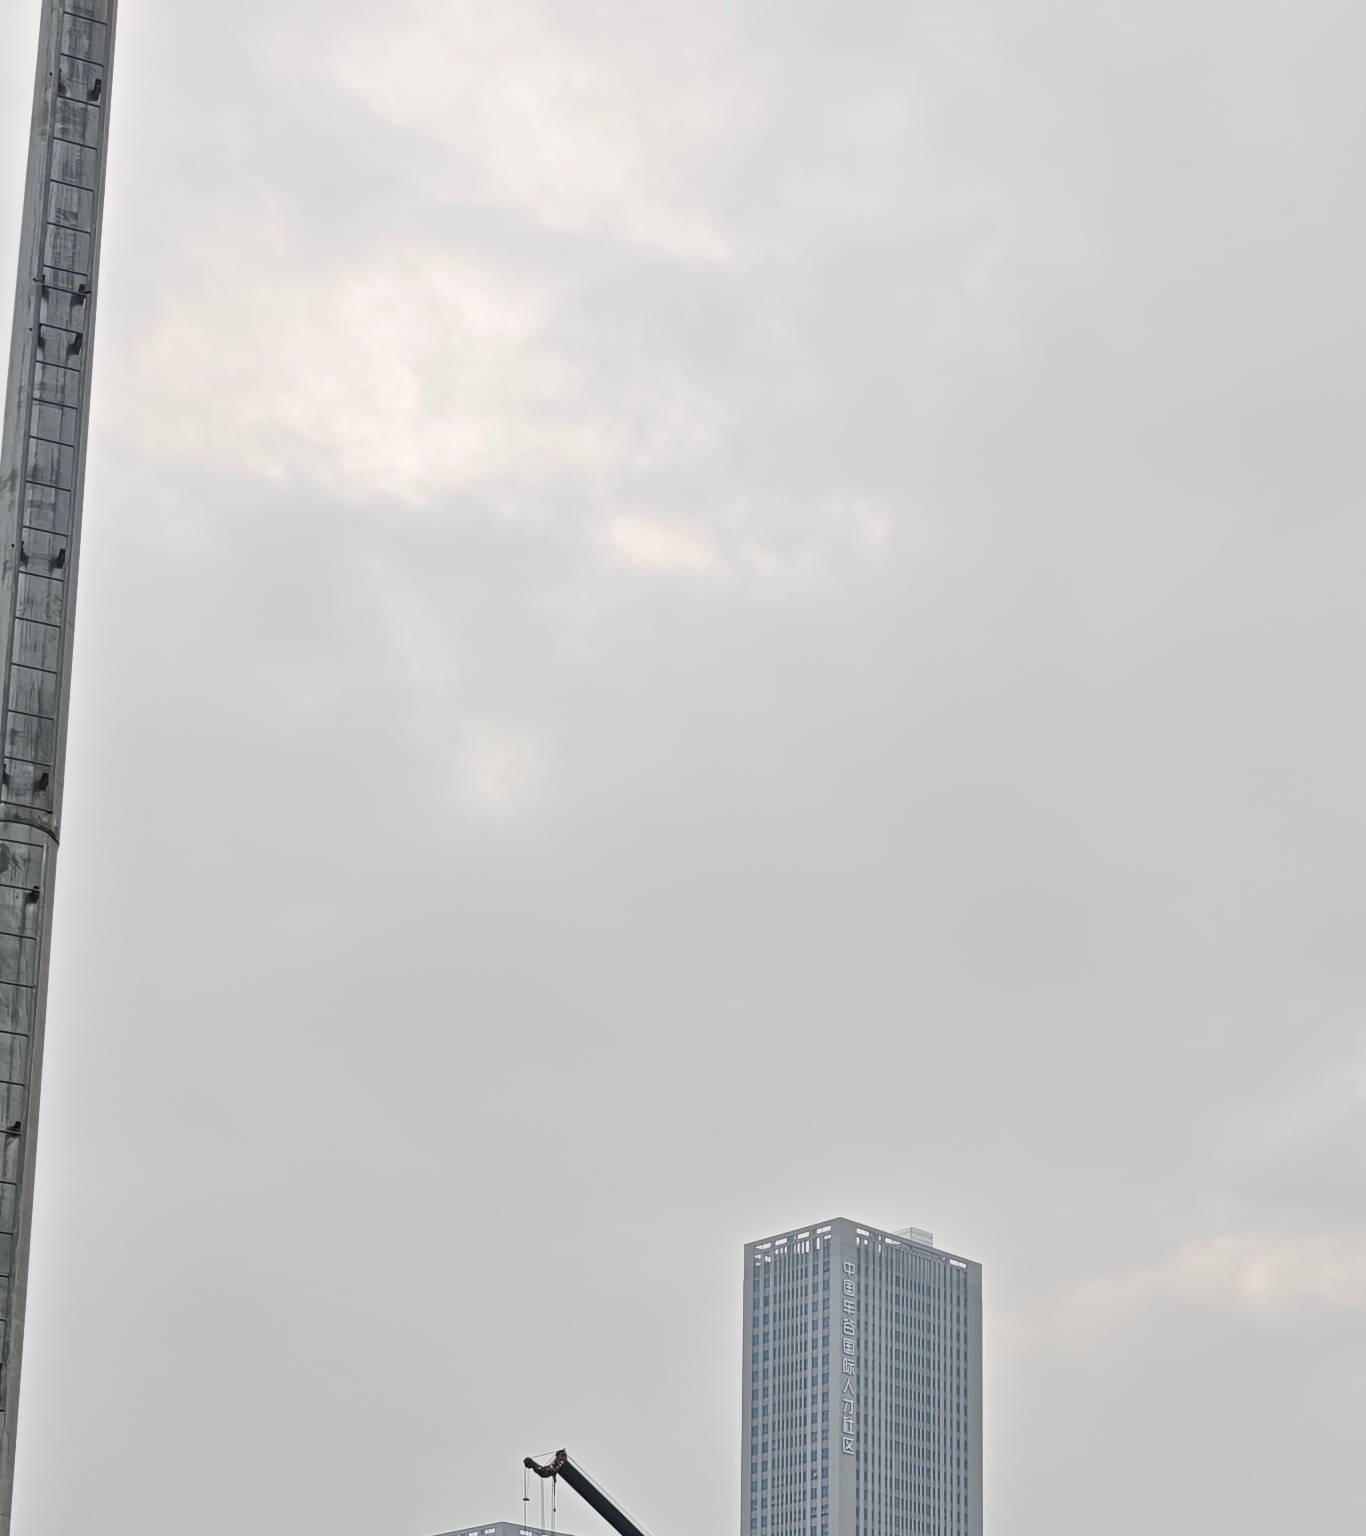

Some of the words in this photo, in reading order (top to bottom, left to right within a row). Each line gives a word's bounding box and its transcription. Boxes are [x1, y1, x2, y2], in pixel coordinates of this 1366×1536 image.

[842, 1261, 856, 1455] 中国车谷国际人才社区
